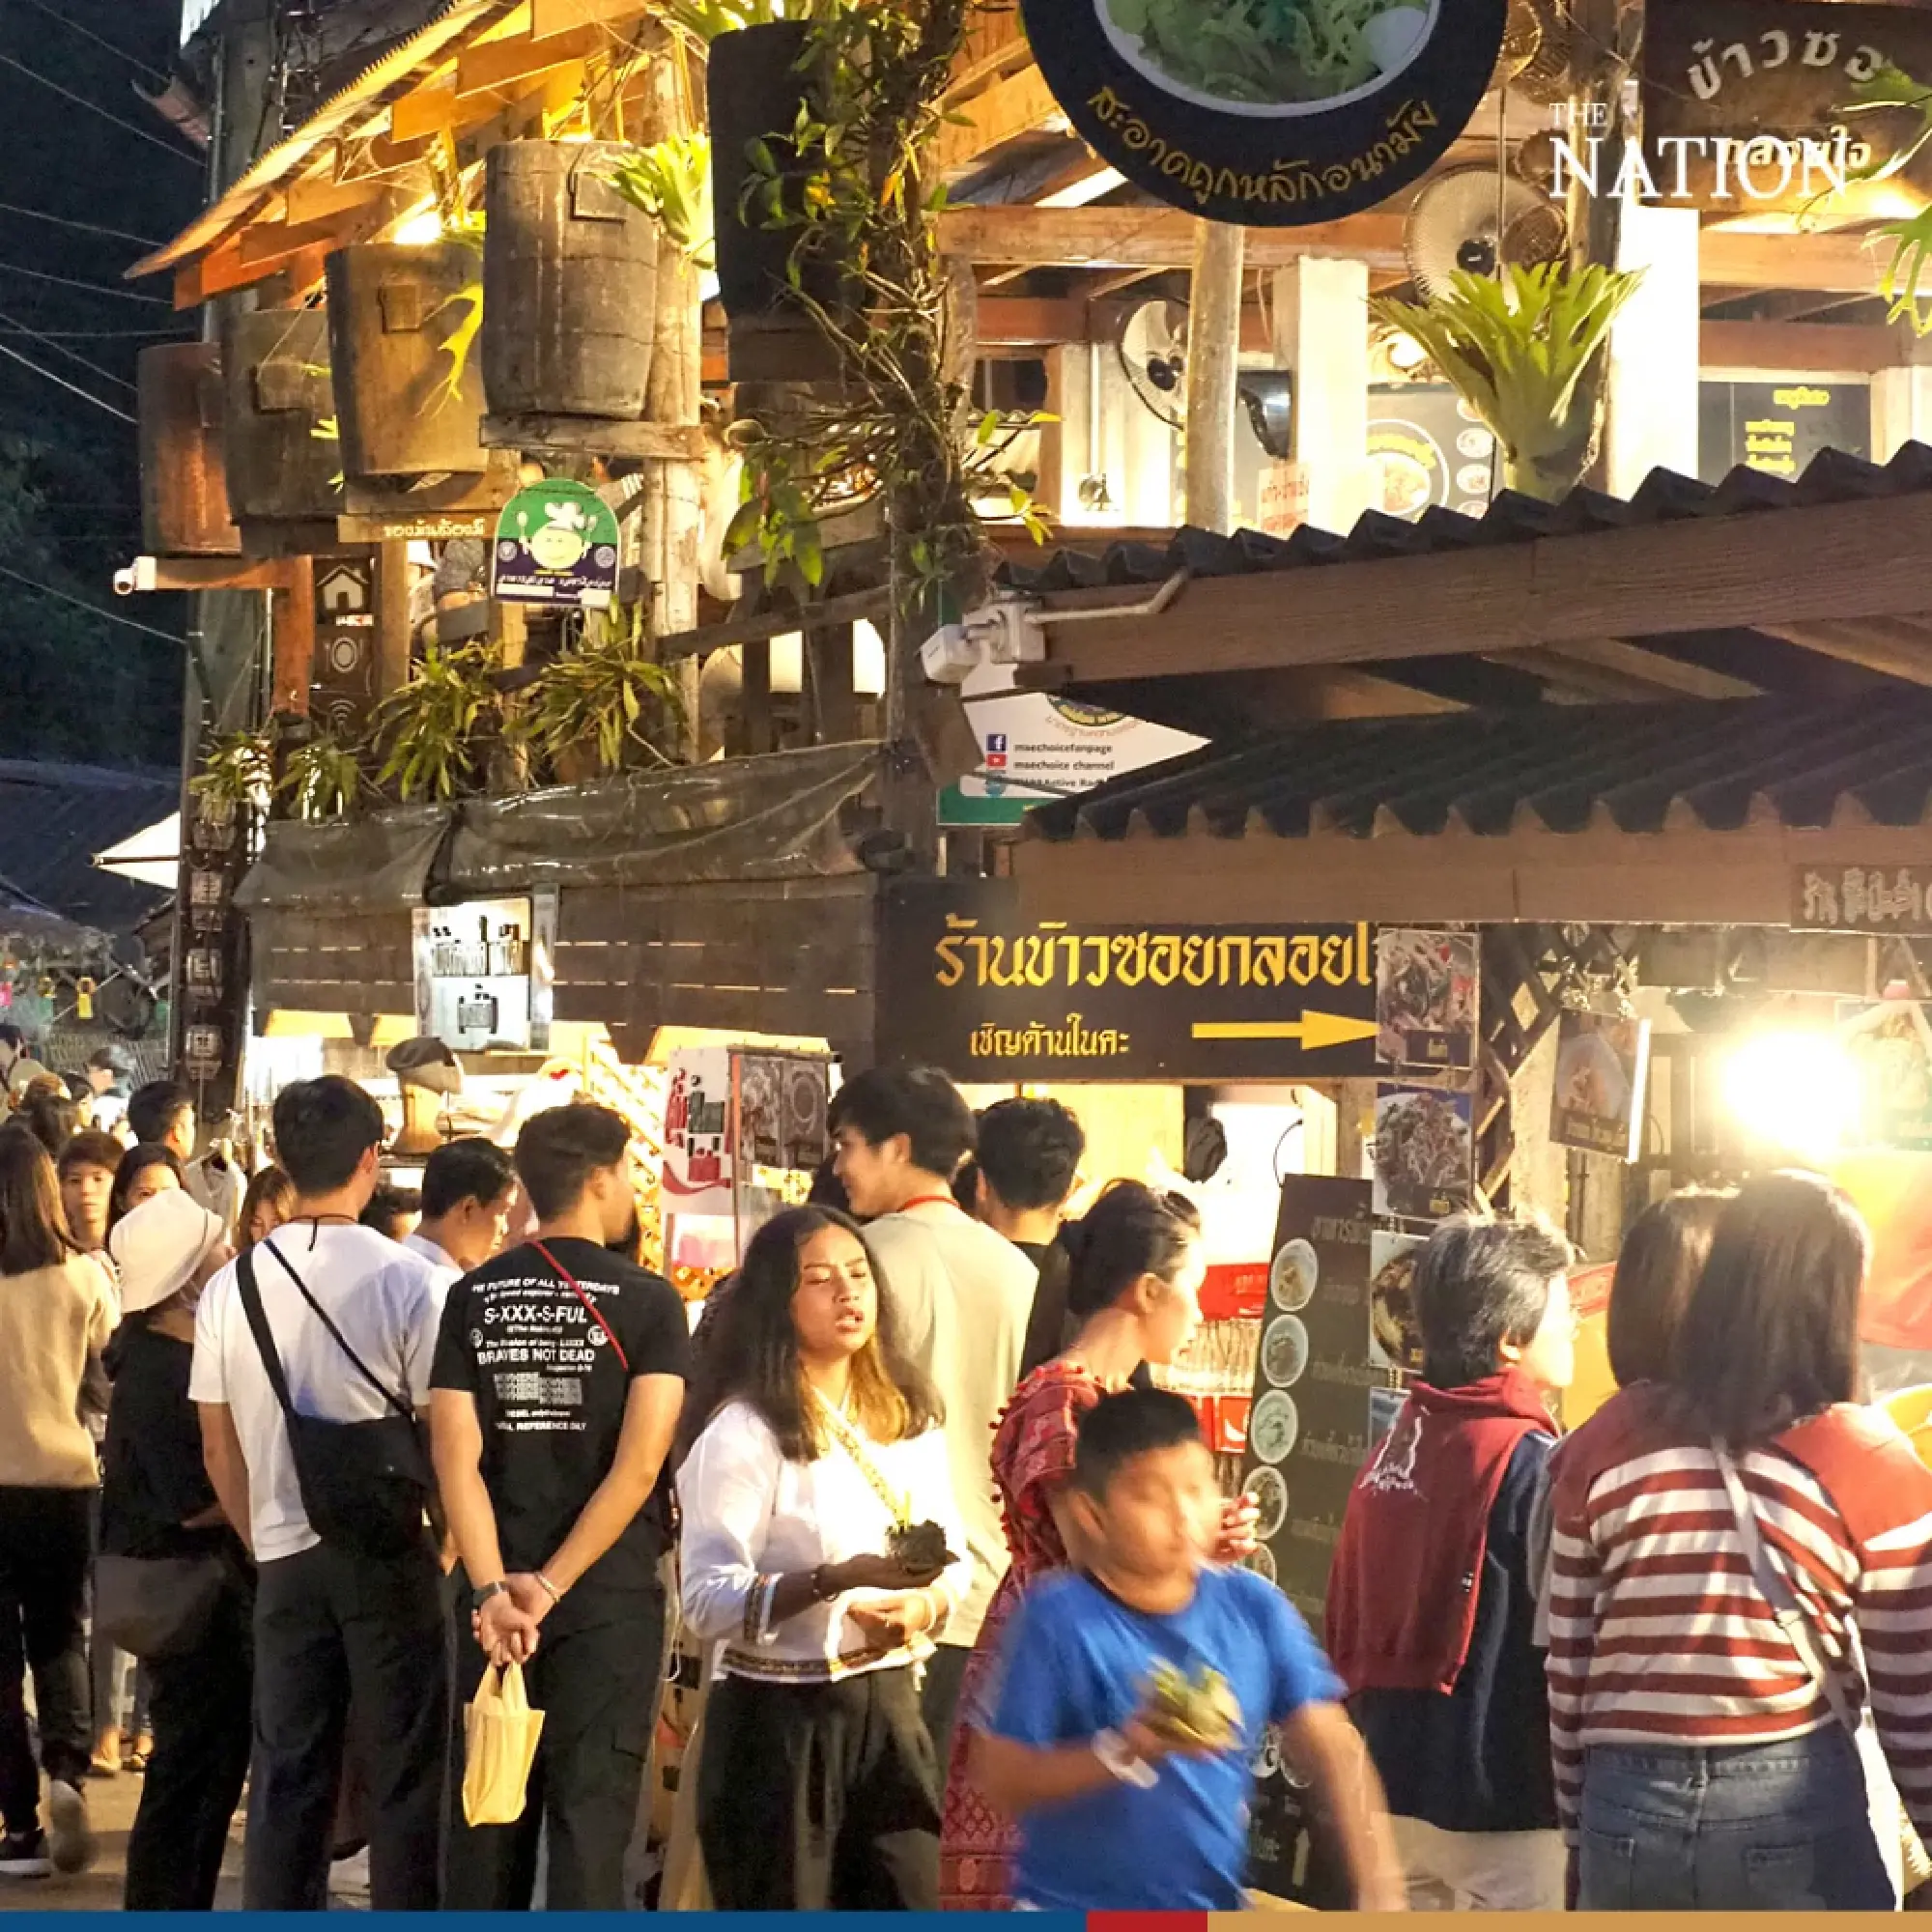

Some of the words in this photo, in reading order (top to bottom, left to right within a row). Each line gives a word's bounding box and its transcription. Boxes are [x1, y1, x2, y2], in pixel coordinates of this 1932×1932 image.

[1687, 29, 1885, 99] ข้าวซอ
[1087, 86, 1439, 204] สะอาดถูกหลักอนามัย
[1013, 743, 1113, 755] maechoicefanpage
[1013, 759, 1069, 771] maechoice
[1072, 759, 1115, 771] channel
[484, 1304, 587, 1324] S-XXX-S-FUL
[531, 1349, 556, 1362] NOT
[559, 1349, 595, 1362] DEAD
